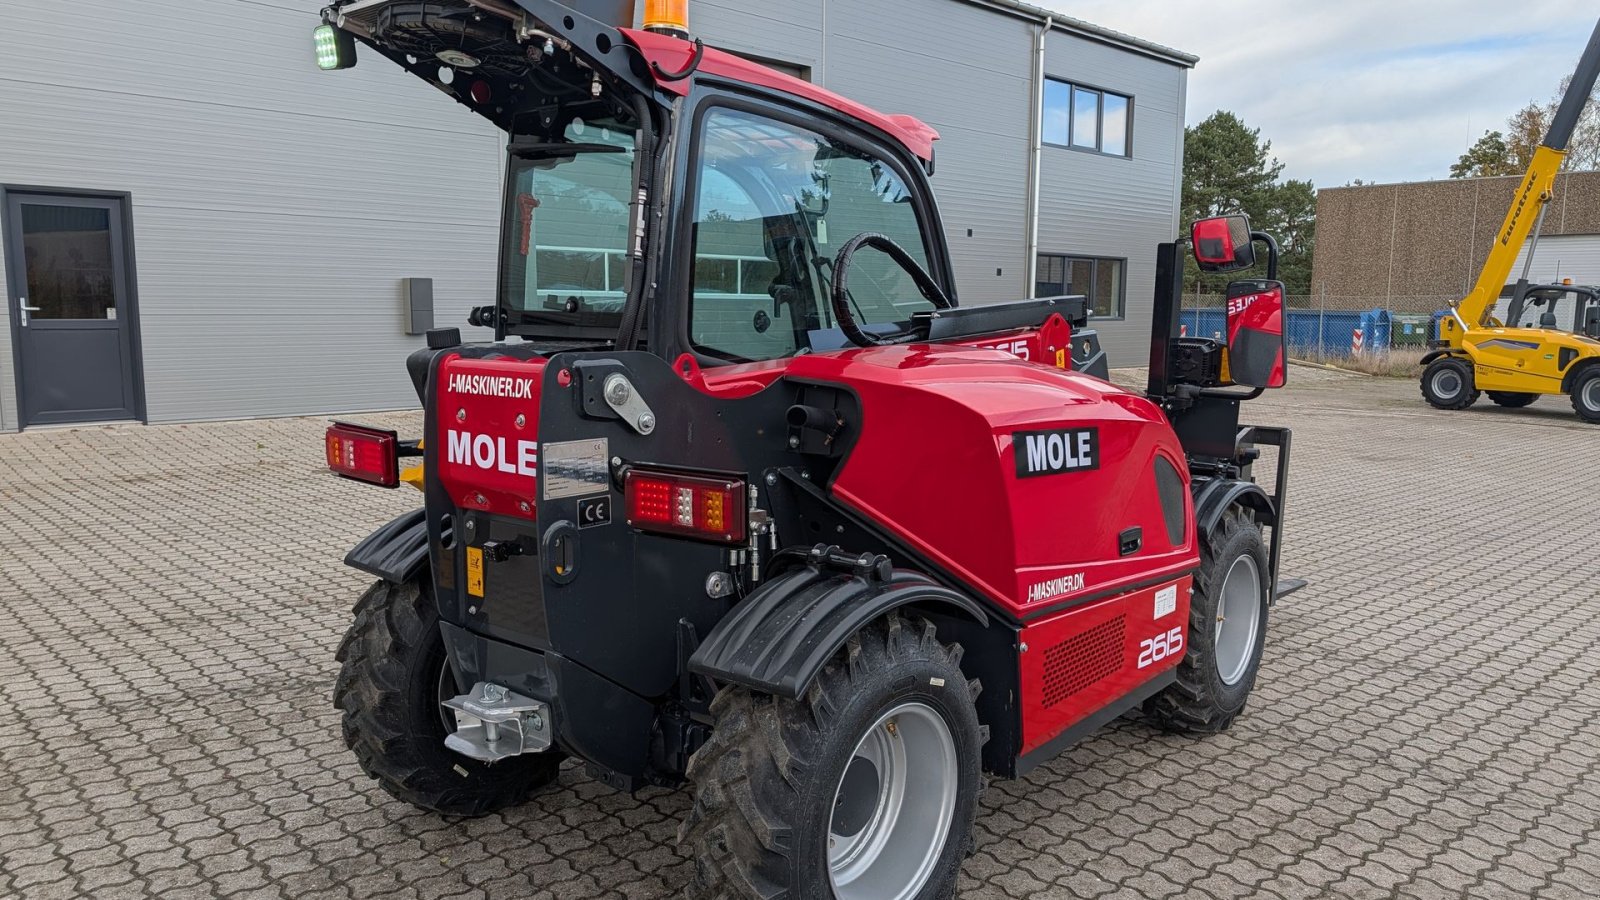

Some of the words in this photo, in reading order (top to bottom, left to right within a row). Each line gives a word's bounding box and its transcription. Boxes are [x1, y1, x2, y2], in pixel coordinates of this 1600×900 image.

[1501, 170, 1537, 247] Eurotrac
[447, 373, 533, 399] J-MASKINER.DK
[447, 429, 537, 477] MOLE
[1025, 432, 1092, 472] MOLE
[585, 502, 604, 521] CE
[1026, 572, 1085, 604] J-MASKINER.DK
[1137, 625, 1183, 669] 2615
